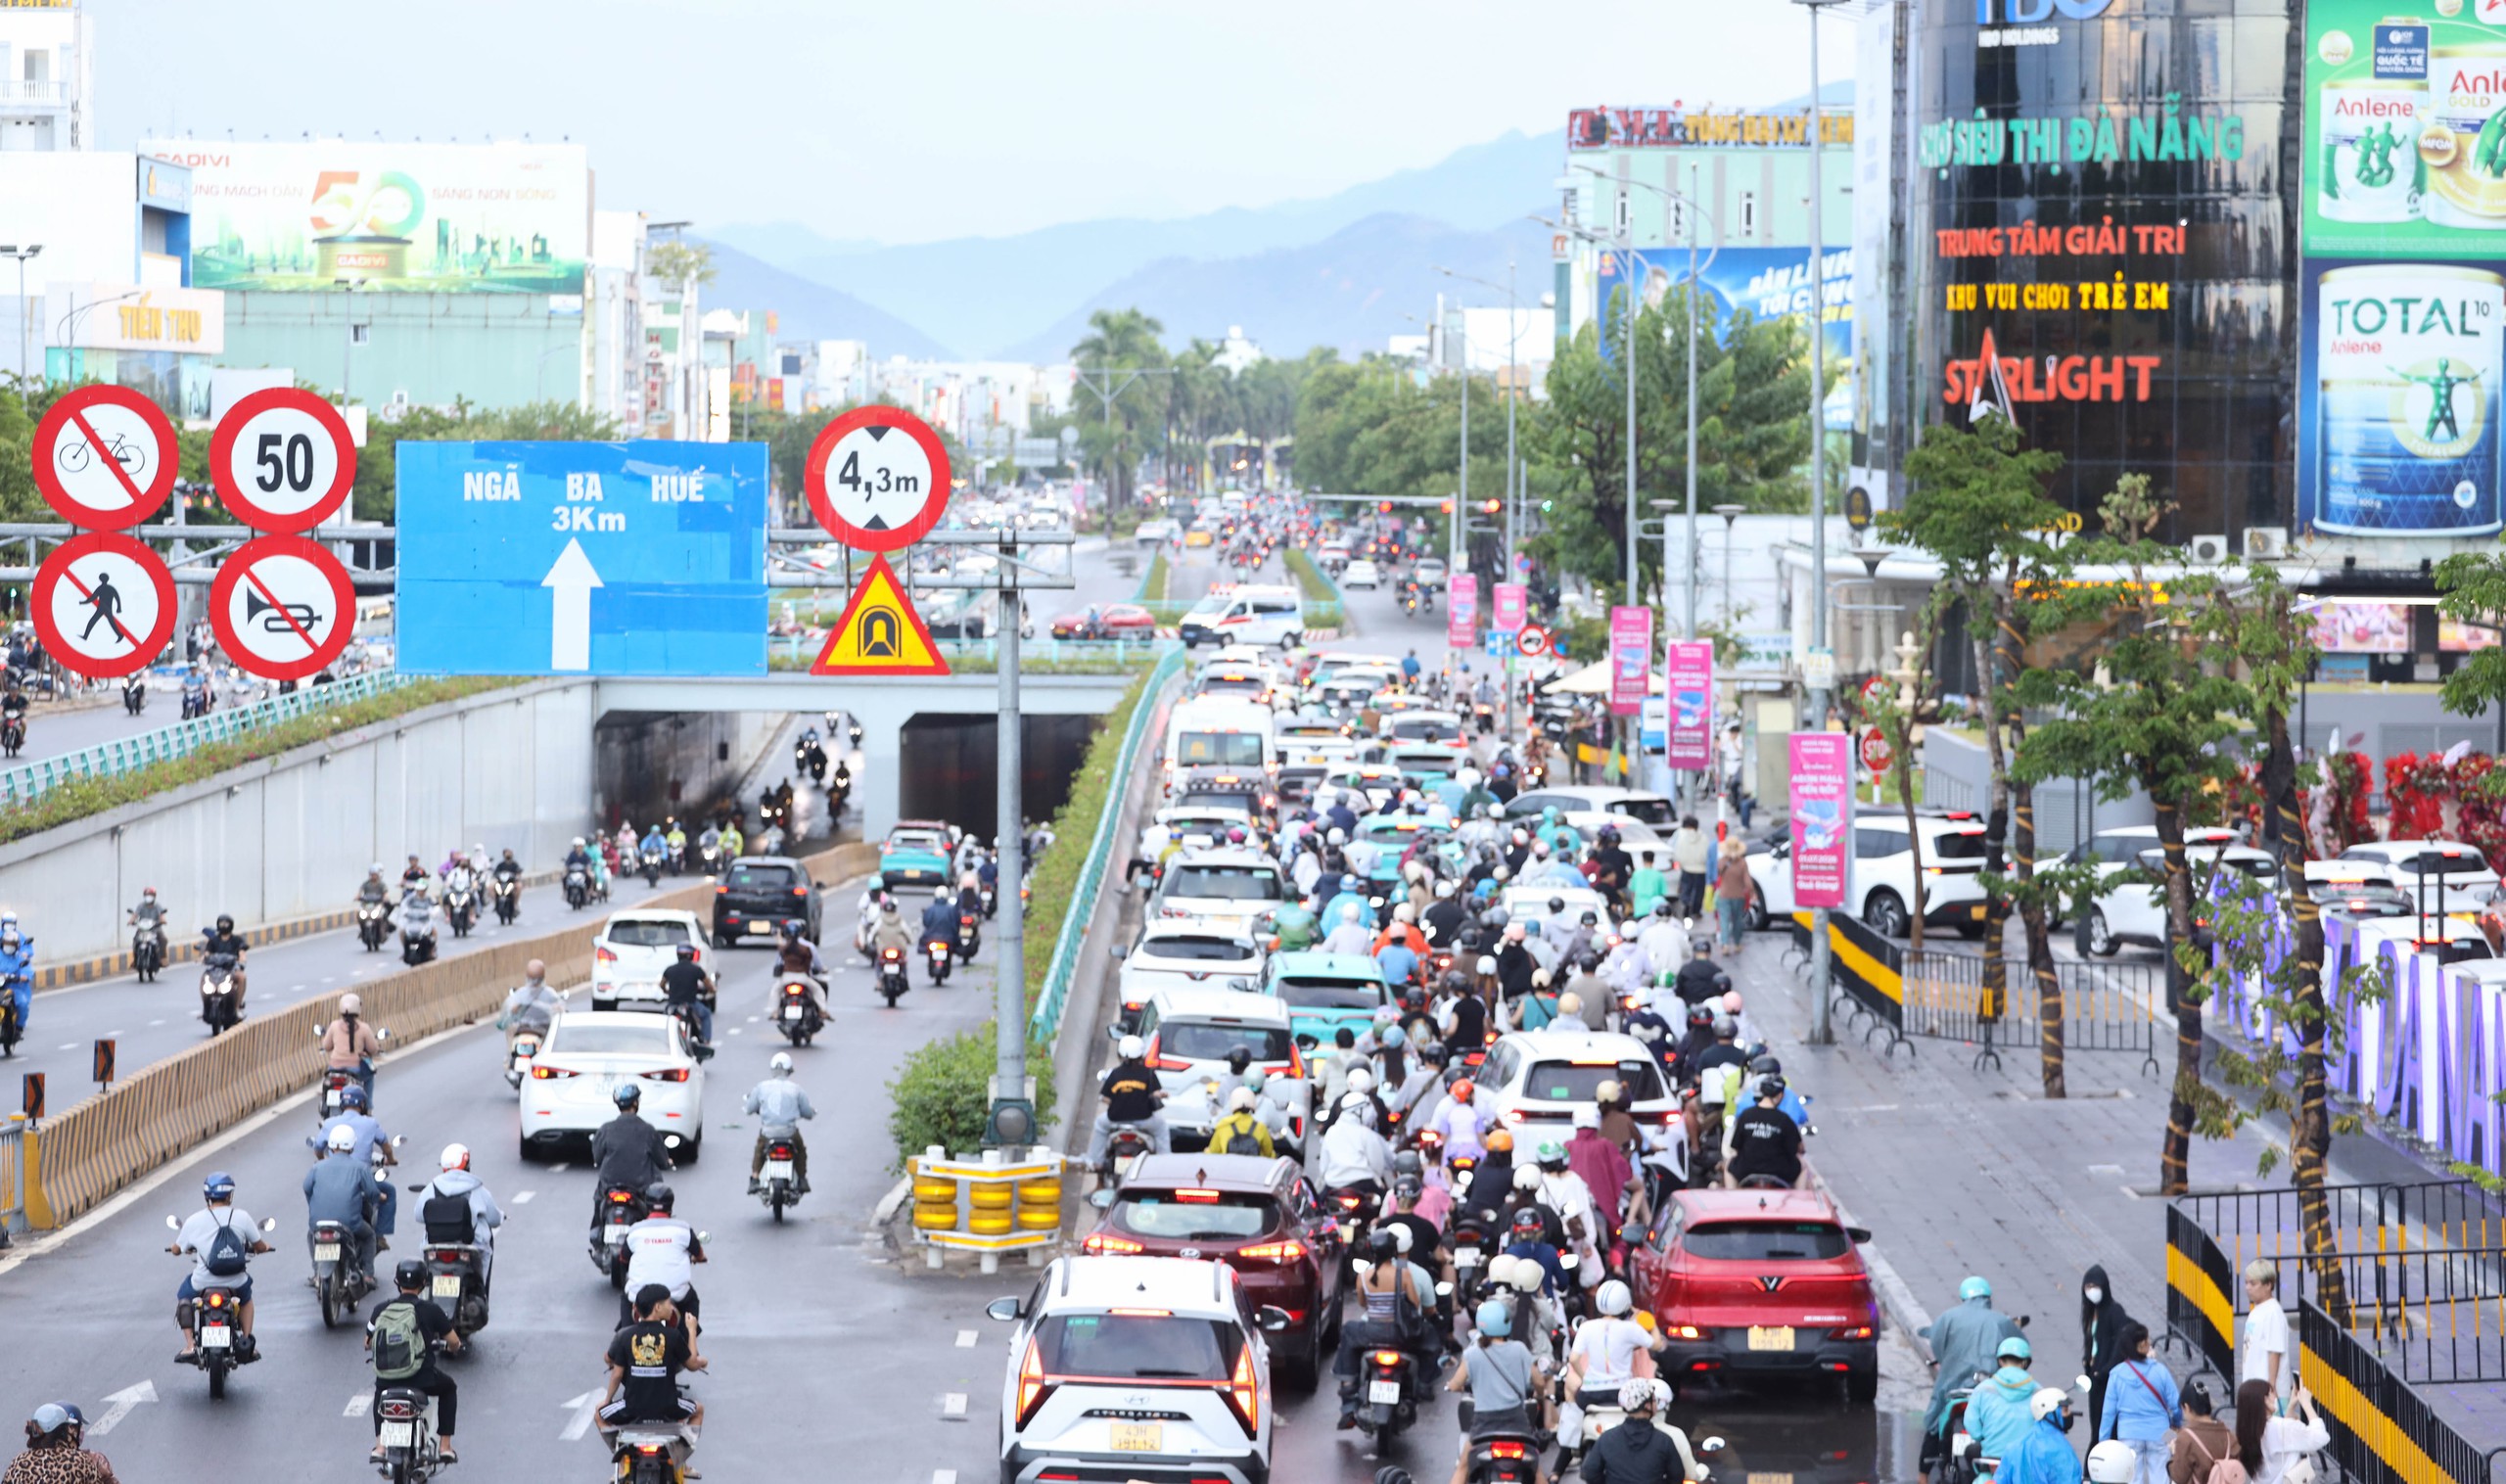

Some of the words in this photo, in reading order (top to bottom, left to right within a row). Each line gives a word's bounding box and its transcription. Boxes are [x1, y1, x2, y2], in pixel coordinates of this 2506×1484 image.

[2335, 96, 2414, 117] Anlene
[2448, 96, 2490, 108] GOLD
[1953, 107, 2005, 165] SIÊU
[2008, 117, 2061, 176] THỊ
[2068, 103, 2119, 162] ĐÀ
[2129, 91, 2244, 162] NẴNG
[154, 153, 230, 167] ADIVI
[1936, 227, 2004, 258] TRUNG
[2006, 218, 2062, 256] TÂM
[2065, 214, 2126, 256] GIẢI
[338, 255, 387, 267] CADIVI
[1946, 283, 1977, 311] KHU
[1984, 283, 2018, 310] VUI
[2078, 270, 2127, 310] TRẺ
[2133, 282, 2169, 310] EM
[118, 291, 162, 340] TIẾN
[2331, 298, 2480, 338] TOTAL
[2475, 301, 2489, 317] 10
[2330, 340, 2383, 355] Anlene
[1942, 326, 2160, 428] STARLIGHT
[255, 434, 314, 492] 50
[463, 463, 522, 502] NGÃ
[566, 473, 604, 502] BA
[651, 465, 705, 503] HUẾ
[839, 450, 919, 503] 4,3m
[551, 507, 626, 533] 3Km
